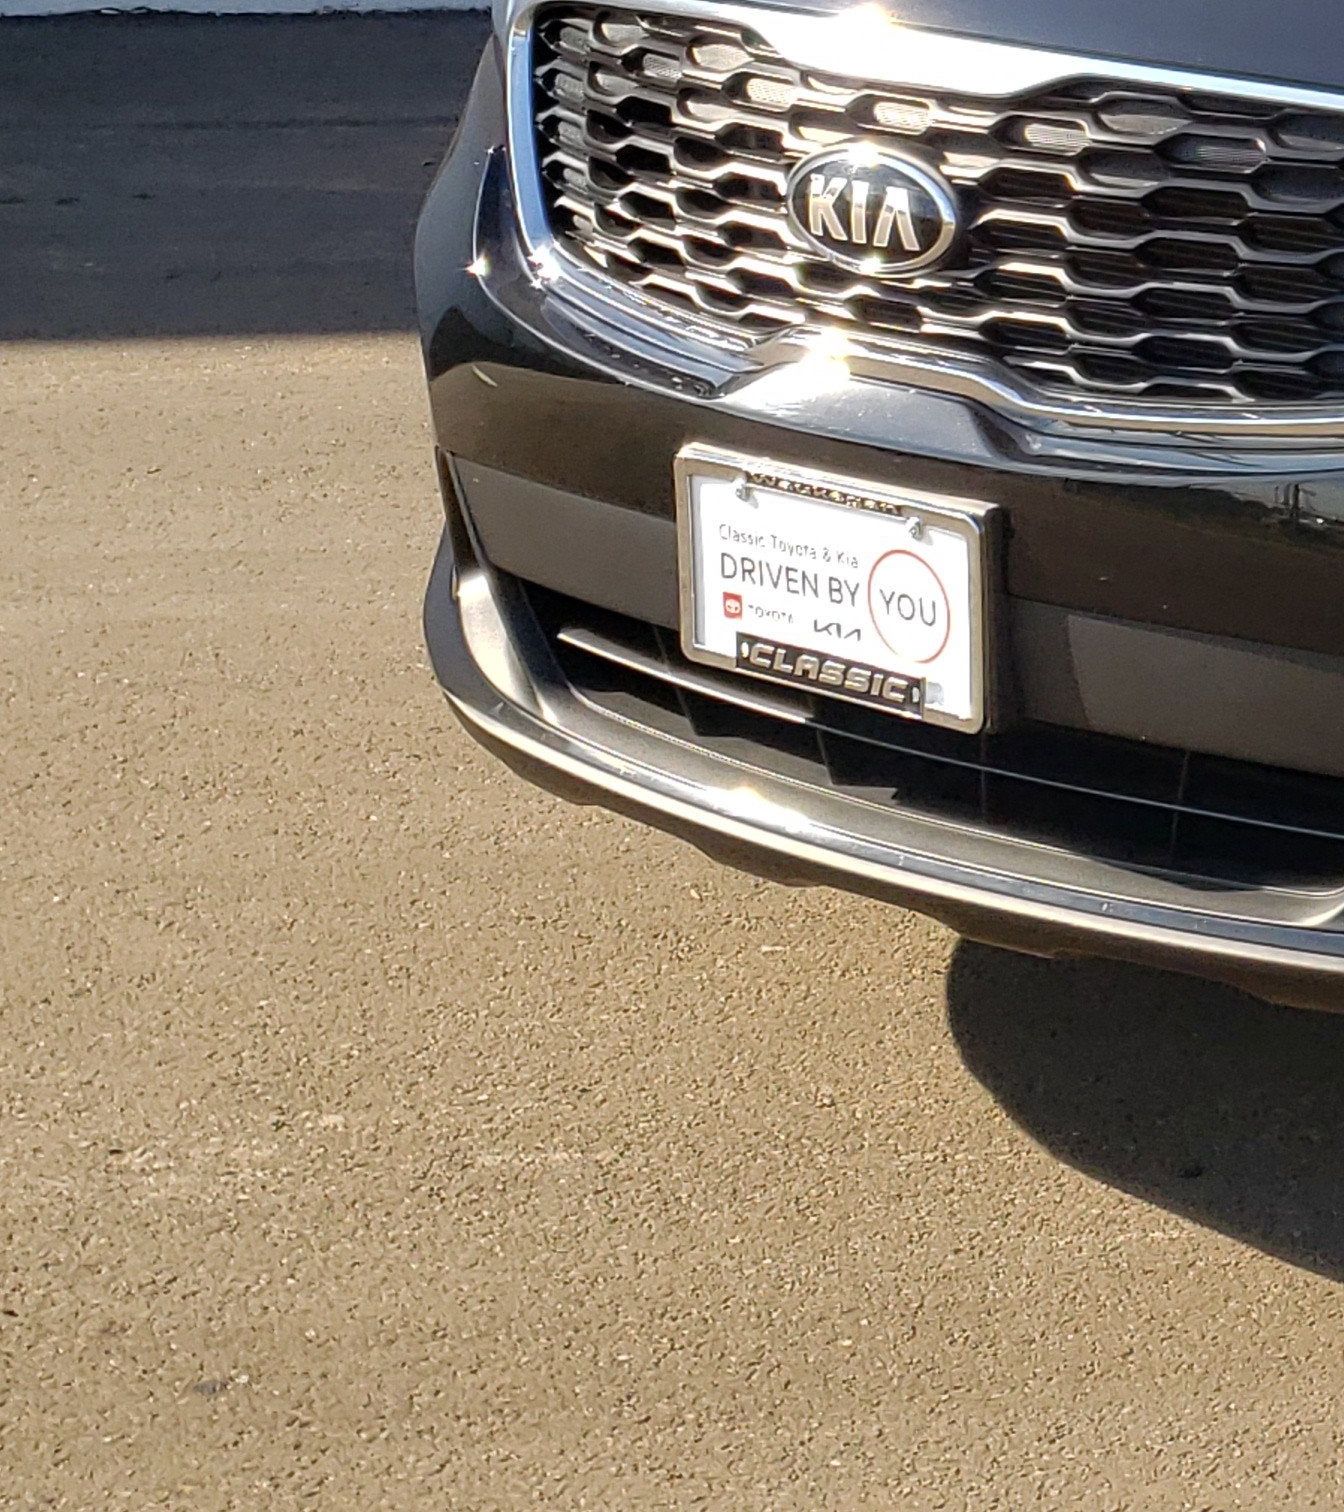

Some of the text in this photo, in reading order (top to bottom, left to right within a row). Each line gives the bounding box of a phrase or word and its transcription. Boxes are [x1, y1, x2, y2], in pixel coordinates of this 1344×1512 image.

[808, 173, 921, 252] KIA
[719, 523, 766, 548] Classic
[770, 534, 817, 560] Toyota
[837, 550, 859, 569] Kia
[720, 552, 937, 627] DRIVEN BY YOU
[749, 642, 910, 703] CLASSIC
